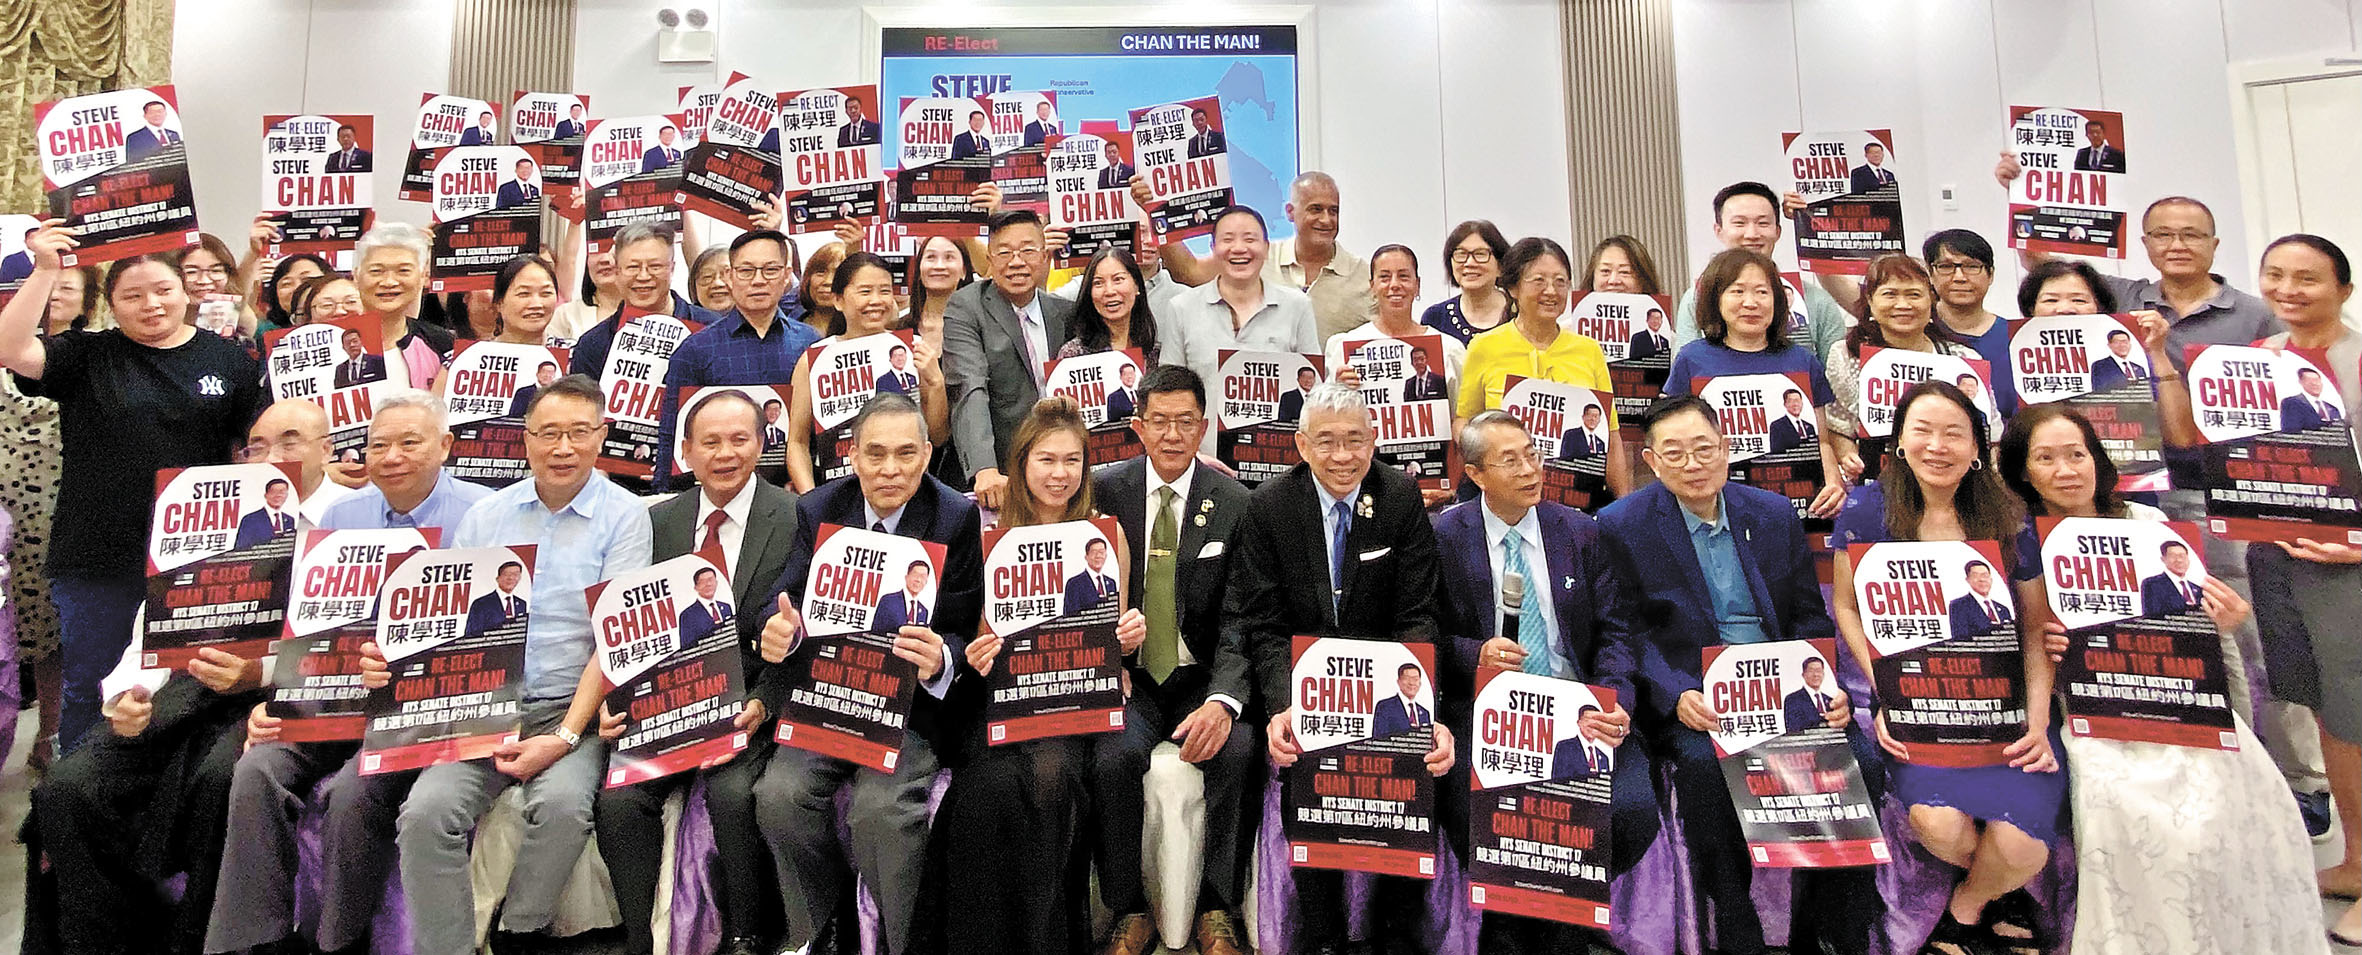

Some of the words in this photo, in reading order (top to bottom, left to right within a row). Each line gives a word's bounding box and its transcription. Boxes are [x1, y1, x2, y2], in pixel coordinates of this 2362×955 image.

[924, 37, 998, 51] RE-Elect
[1121, 34, 1173, 51] CHAN
[1176, 35, 1210, 50] THE
[1214, 34, 1260, 49] MAN!
[931, 74, 1012, 99] STEVE
[440, 104, 467, 117] STEVE
[532, 100, 557, 112] STEVE
[746, 90, 777, 112] STEVE
[800, 94, 839, 111] RE-ELECT
[994, 101, 1023, 115] STEVE
[72, 106, 119, 126] STEVE
[421, 113, 466, 134] CHAN
[516, 110, 557, 128] CHAN
[719, 97, 774, 134] CHAN
[783, 110, 837, 133] 陳學理
[922, 108, 953, 121] STEVE
[1150, 108, 1185, 126] RE-ELECT
[2035, 114, 2078, 130] RE-ELECT
[49, 122, 124, 156] CHAN
[288, 122, 331, 135] RE-ELECT
[609, 126, 642, 140] STEVE
[711, 118, 757, 147] 陳學理
[904, 122, 953, 145] CHAN
[1136, 124, 1186, 147] 陳學理
[2015, 128, 2076, 149] 陳學理
[269, 136, 326, 154] 陳學理
[591, 139, 643, 163] CHAN
[789, 136, 823, 153] STEVE
[1065, 139, 1099, 153] RE-ELECT
[1809, 143, 1845, 156] STEVE
[272, 160, 309, 174] STEVE
[461, 157, 497, 172] STEVE
[796, 148, 868, 185] CHAN
[1050, 154, 1098, 173] 陳學理
[1144, 150, 1175, 167] STEVE
[1792, 157, 1850, 180] CHAN
[2020, 152, 2058, 169] STEVE
[440, 172, 497, 196] CHAN
[1055, 177, 1085, 192] STEVE
[1152, 159, 1218, 196] CHAN
[2025, 170, 2107, 207] CHAN
[277, 176, 355, 207] CHAN
[1061, 189, 1124, 223] CHAN
[1596, 304, 1630, 319] STEVE
[290, 329, 334, 349] RE-ELECT
[643, 319, 683, 342] RE-ELECT
[2039, 329, 2084, 346] STEVE
[617, 332, 675, 360] 陳學理
[1367, 345, 1405, 361] RE-ELECT
[273, 351, 333, 377] 陳學理
[479, 355, 519, 372] STEVE
[614, 358, 652, 381] STEVE
[835, 349, 871, 370] STEVE
[1243, 362, 1280, 378] STEVE
[2018, 345, 2089, 374] CHAN
[2222, 360, 2273, 379] STEVE
[453, 369, 517, 400] CHAN
[817, 366, 875, 400] CHAN
[1069, 366, 1102, 385] STEVE
[2022, 375, 2085, 394] 陳學理
[281, 377, 317, 400] STEVE
[1224, 375, 1280, 403] CHAN
[1723, 389, 1763, 407] STEVE
[2199, 377, 2278, 410] CHAN
[449, 397, 505, 417] 陳學理
[1224, 402, 1273, 420] 陳學理
[1529, 391, 1566, 411] STEVE
[2203, 408, 2271, 431] 陳學理
[193, 479, 240, 500] STEVE
[164, 498, 240, 534] CHAN
[159, 532, 228, 556] 陳學理
[337, 545, 385, 563] STEVE
[1018, 541, 1062, 563] STEVE
[2077, 535, 2132, 556] STEVE
[843, 545, 887, 572] STEVE
[1887, 559, 1940, 580] STEVE
[303, 564, 382, 598] CHAN
[422, 563, 473, 583] STEVE
[993, 561, 1064, 599] CHAN
[2053, 555, 2139, 593] CHAN
[623, 578, 671, 608] STEVE
[814, 563, 883, 608] CHAN
[389, 582, 472, 621] CHAN
[1865, 581, 1947, 616] CHAN
[2059, 592, 2134, 616] 陳學理
[297, 599, 365, 621] 陳學理
[809, 599, 867, 630] 陳學理
[994, 598, 1057, 623] 陳學理
[386, 619, 457, 646] 陳學理
[602, 597, 678, 648] CHAN
[1872, 618, 1944, 640] 陳學理
[1038, 631, 1084, 650] RE-ELECT
[431, 652, 485, 674] RE-ELECT
[608, 634, 673, 672] 陳學理
[1009, 654, 1043, 675] CHAN
[1047, 650, 1070, 671] THE
[1326, 656, 1373, 678] STEVE
[1735, 658, 1780, 678] STEVE
[395, 674, 436, 701] CHAN
[440, 674, 466, 698] THE
[1300, 676, 1373, 714] CHAN
[1713, 678, 1782, 714] CHAN
[1509, 690, 1555, 717] STEVE
[1300, 714, 1365, 738] 陳學理
[1482, 708, 1555, 755] CHAN
[1344, 755, 1394, 774] RE-ELECT
[1480, 747, 1545, 779] 陳學理
[1314, 773, 1350, 796] CHAN
[1353, 775, 1378, 798] THE
[1381, 778, 1416, 801] MAN!
[1337, 797, 1364, 811] SENATE
[1364, 799, 1396, 814] DISTRICT
[1523, 796, 1573, 820] RE-ELECT
[1492, 812, 1528, 839] CHAN
[1531, 817, 1556, 843] THE
[1559, 824, 1594, 850] MAN!
[1515, 839, 1541, 855] SENATE
[1541, 844, 1573, 861] DISTRICT
